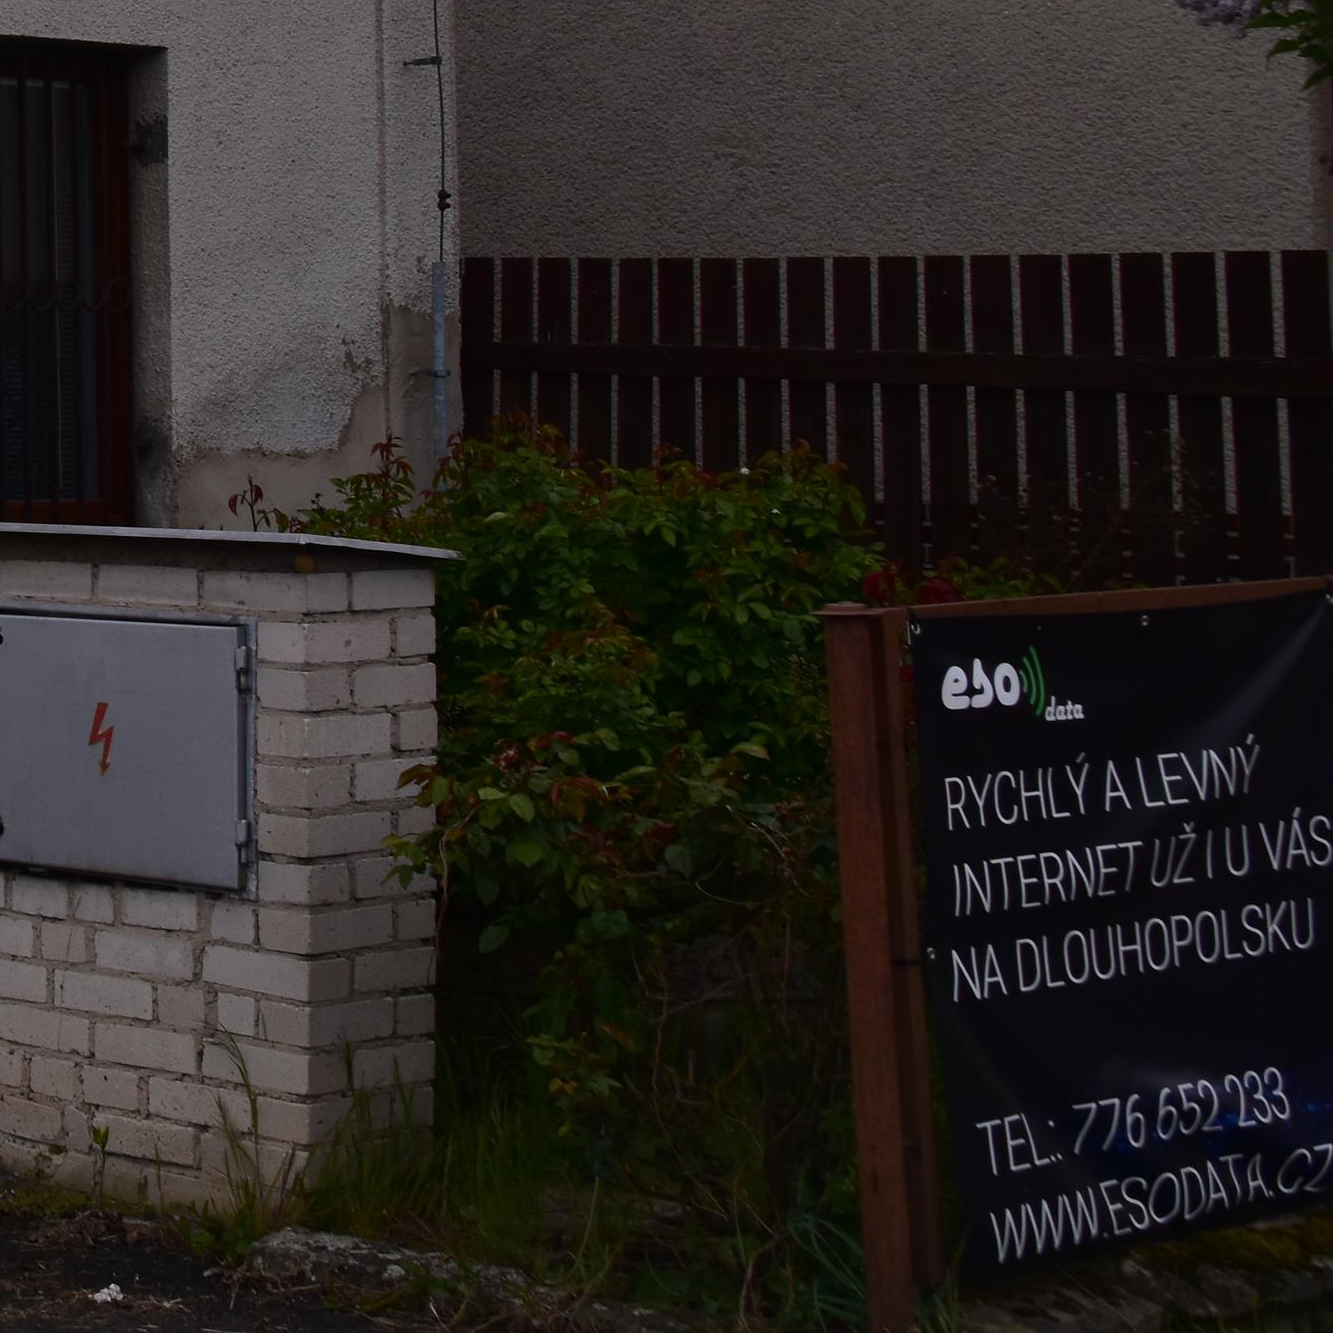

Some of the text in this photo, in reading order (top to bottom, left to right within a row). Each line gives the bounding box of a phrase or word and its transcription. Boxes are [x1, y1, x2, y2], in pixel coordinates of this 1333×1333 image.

[941, 657, 1021, 710] eso
[1044, 695, 1085, 722] data
[944, 733, 1261, 831] RYCHLÝ A LEVNÝ
[952, 805, 1333, 917] INTERNET UŽ I U VÁS
[951, 896, 1316, 1003] NA DLOUHOPOLSKU
[1071, 1092, 1147, 1155] 776
[1156, 1078, 1223, 1142] 652
[1224, 1066, 1292, 1129] 233
[989, 1143, 1333, 1265] WWW.ESODATA.CZ
